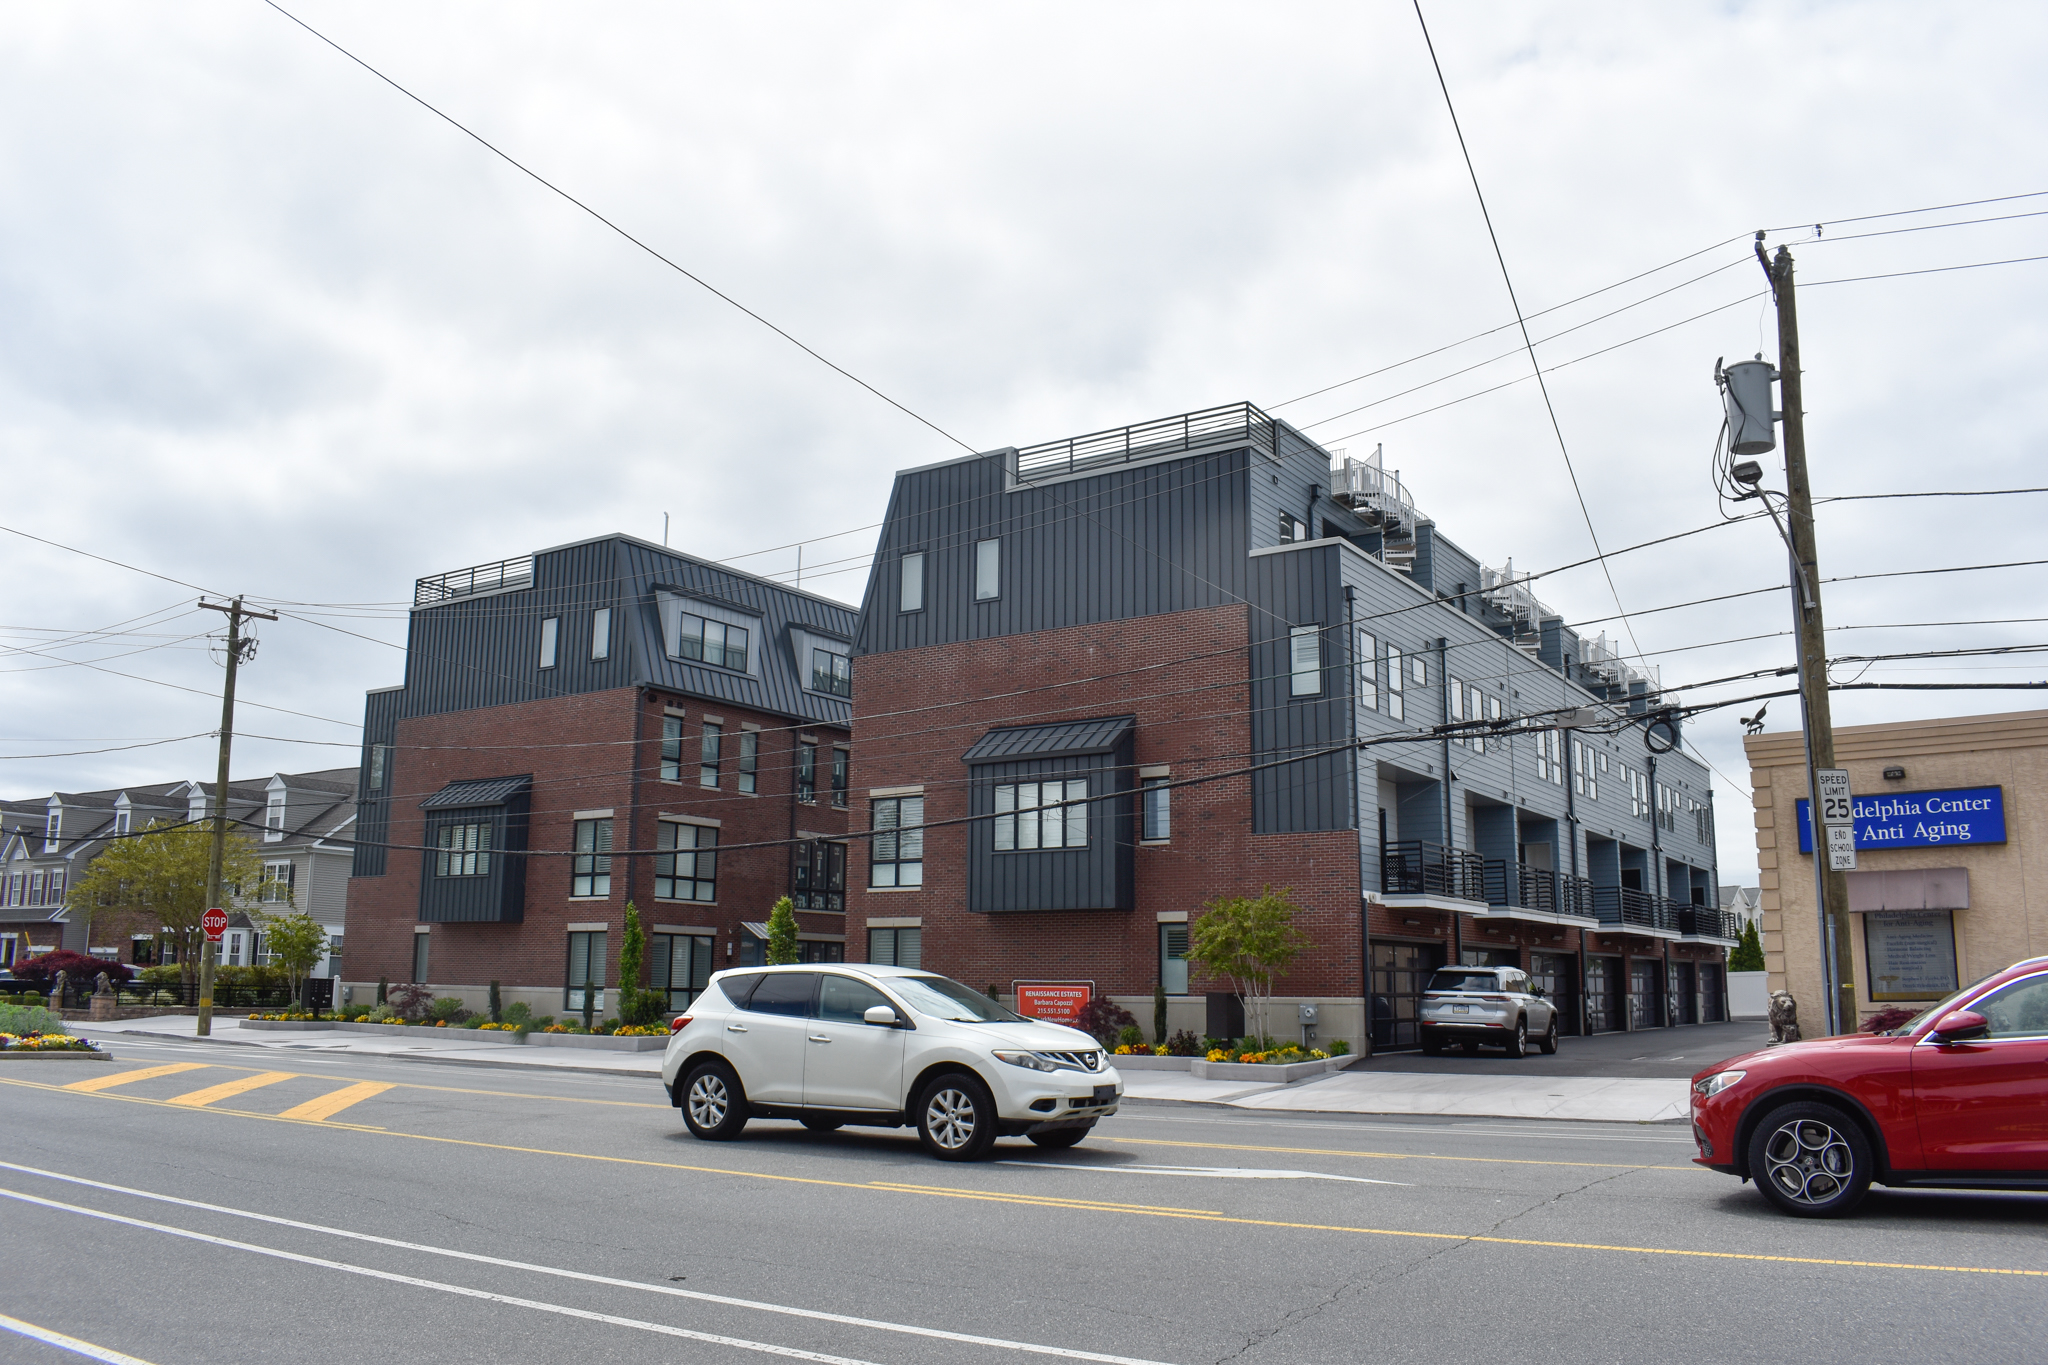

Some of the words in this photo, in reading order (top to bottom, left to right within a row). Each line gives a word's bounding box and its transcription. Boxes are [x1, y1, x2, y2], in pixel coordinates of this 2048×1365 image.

[1820, 775, 1847, 784] SPEED
[1824, 787, 1845, 796] LIMIT
[1807, 800, 1921, 822] delphia
[1925, 797, 1991, 814] Center
[1824, 798, 1849, 818] 25
[1834, 830, 1847, 840] END
[1862, 824, 1905, 841] Anti
[1913, 821, 1971, 842] Aging
[1830, 843, 1853, 852] SCHOOL
[1835, 855, 1851, 865] ZONE
[204, 917, 226, 927] STOP
